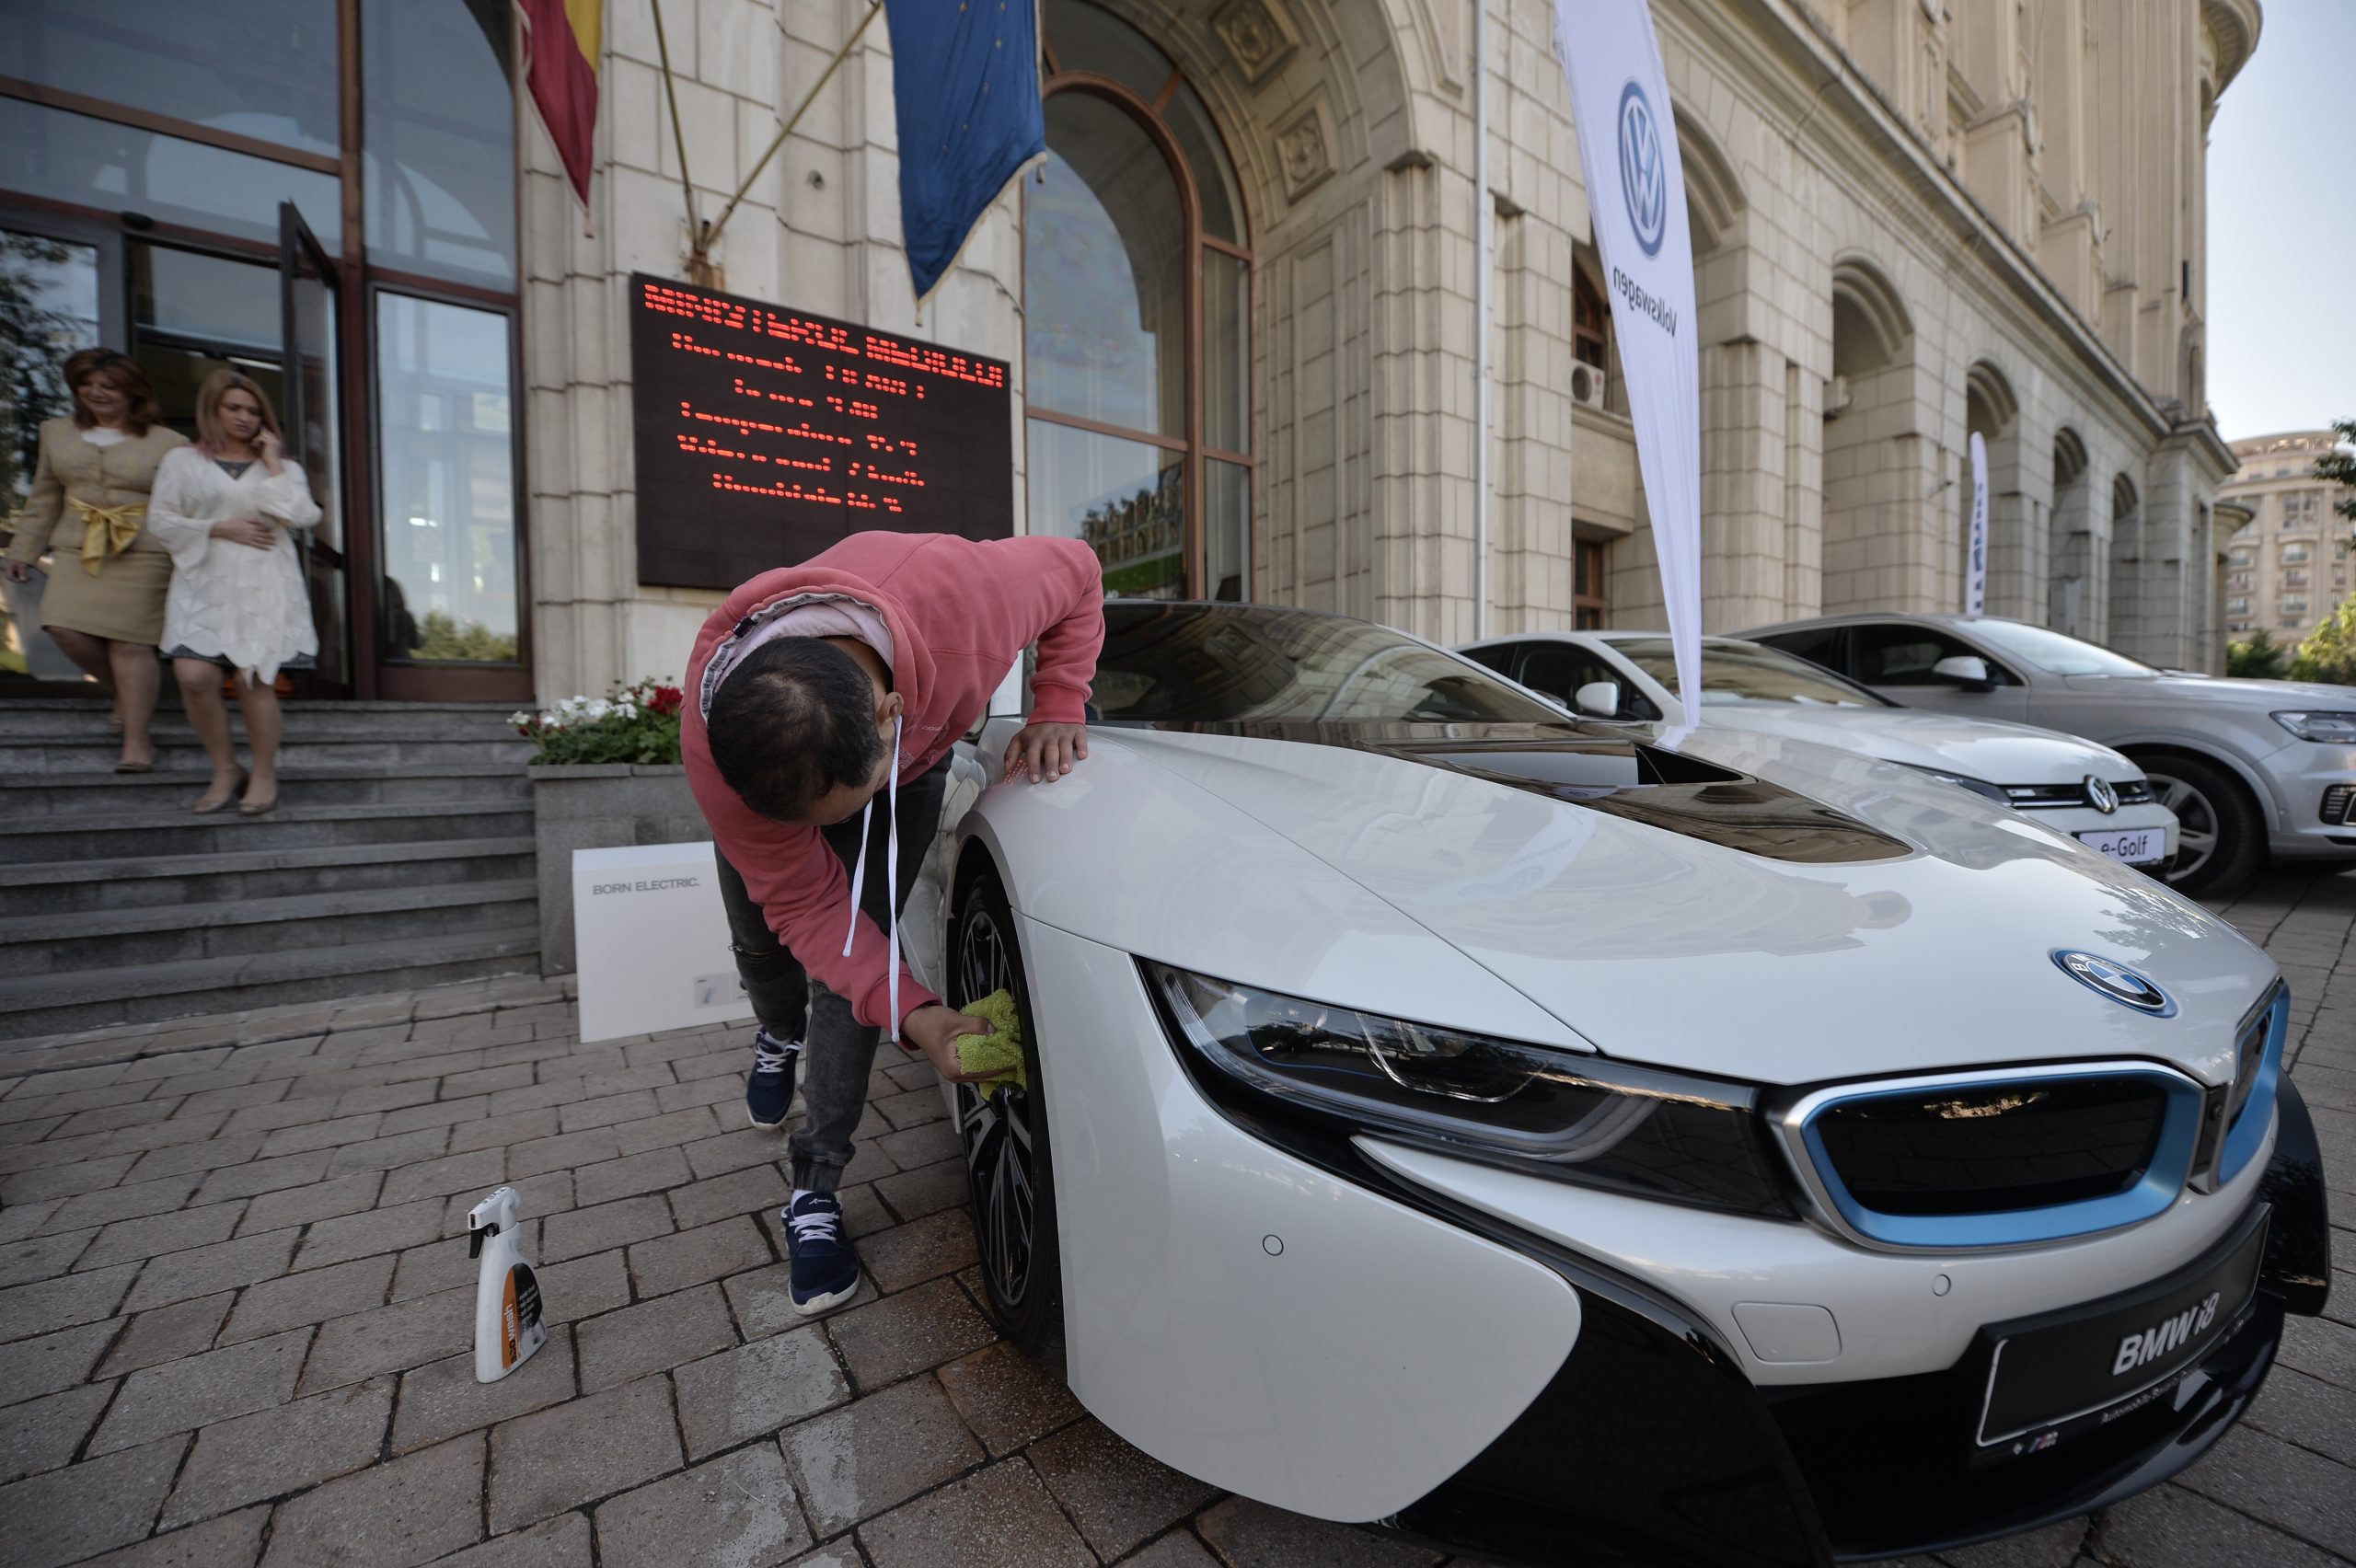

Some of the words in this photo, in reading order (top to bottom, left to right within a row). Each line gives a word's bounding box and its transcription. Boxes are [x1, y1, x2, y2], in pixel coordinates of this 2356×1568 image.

[2101, 836, 2149, 857] e-Golf
[593, 883, 632, 895] BORN
[635, 877, 700, 892] ELECTRIC.
[2111, 1307, 2199, 1377] BMW
[2195, 1291, 2221, 1336] i8
